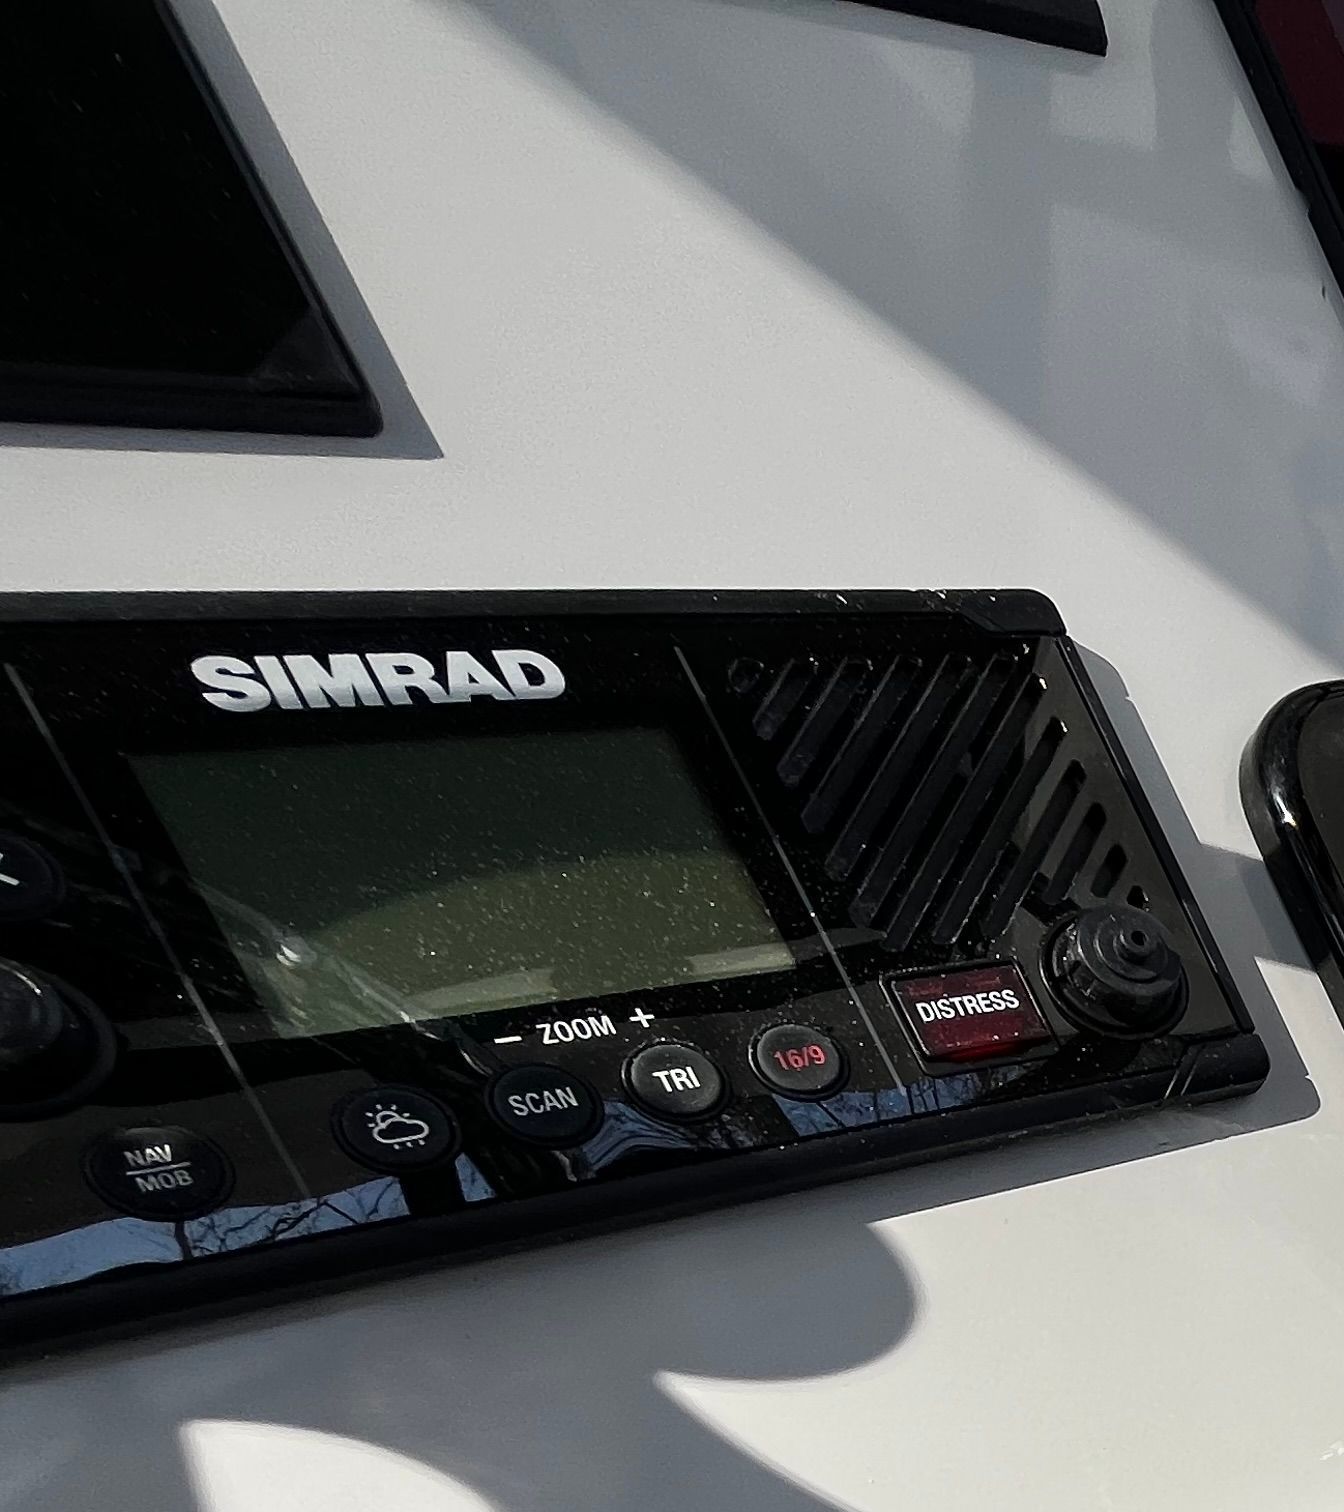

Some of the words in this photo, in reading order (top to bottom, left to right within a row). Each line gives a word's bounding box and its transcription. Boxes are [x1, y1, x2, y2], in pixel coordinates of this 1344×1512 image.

[190, 648, 566, 712] SIMRAD
[916, 989, 1020, 1025] DISTRESS
[538, 1016, 618, 1046] ZOOM
[774, 1044, 826, 1072] 16/9
[652, 1066, 701, 1096] TRI
[508, 1087, 579, 1117] SCAN
[124, 1143, 173, 1168] NAV
[135, 1169, 193, 1194] MOB
